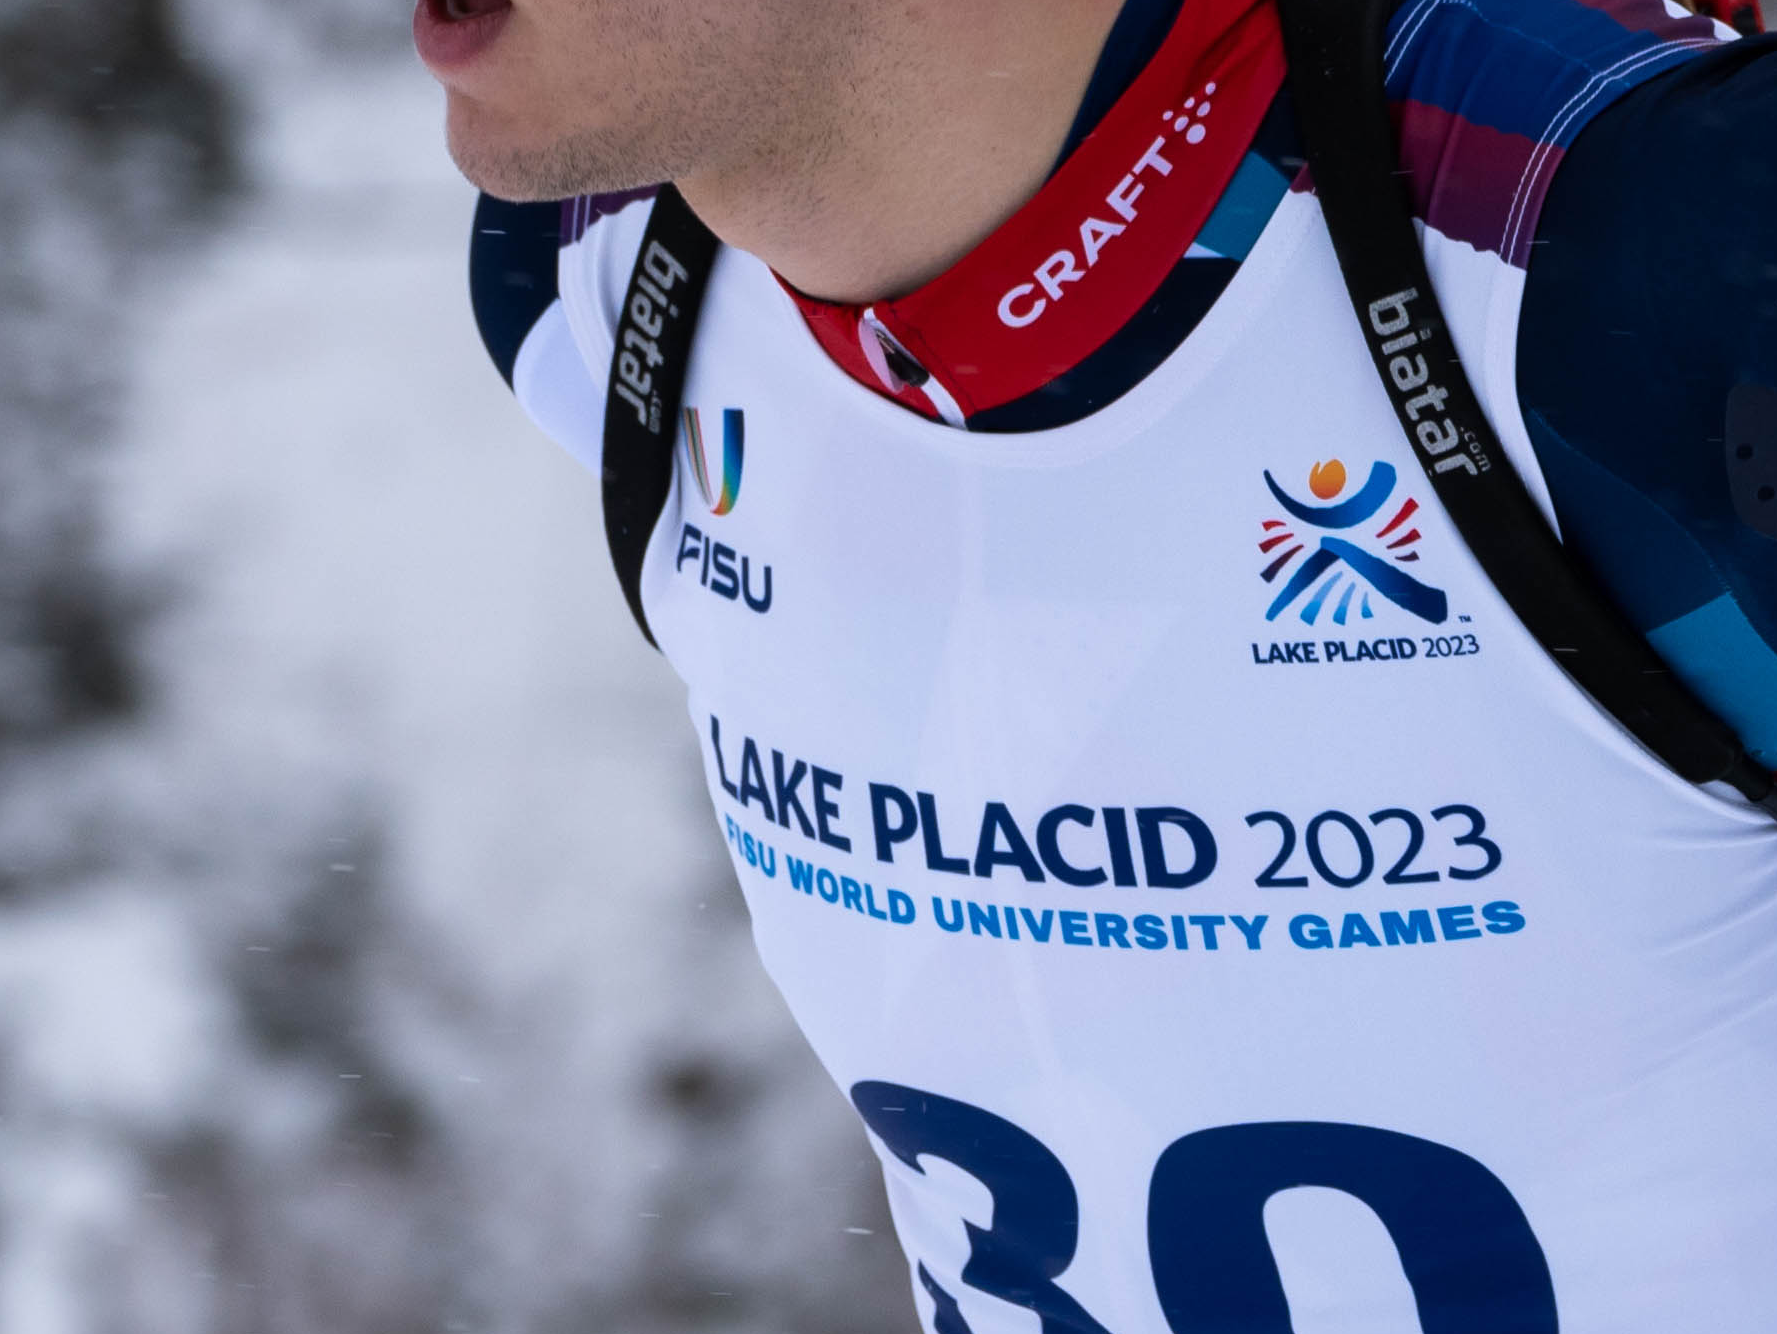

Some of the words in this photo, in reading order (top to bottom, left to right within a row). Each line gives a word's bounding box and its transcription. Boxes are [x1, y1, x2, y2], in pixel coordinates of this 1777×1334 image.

[997, 134, 1173, 329] CRAFT
[614, 239, 689, 427] biatar
[1368, 287, 1478, 476] biatar
[676, 522, 773, 615] FISU
[1251, 642, 1320, 665] LAKE
[1323, 637, 1418, 663] PLACID
[1422, 634, 1481, 659] 2023
[709, 712, 853, 854] LAKE
[868, 780, 1219, 890] PLACID
[1244, 803, 1503, 890] 2023
[724, 811, 778, 879] FISU
[785, 853, 917, 926] WORLD
[932, 895, 1270, 951] UNIVERSITY
[1288, 900, 1527, 950] GAMES
